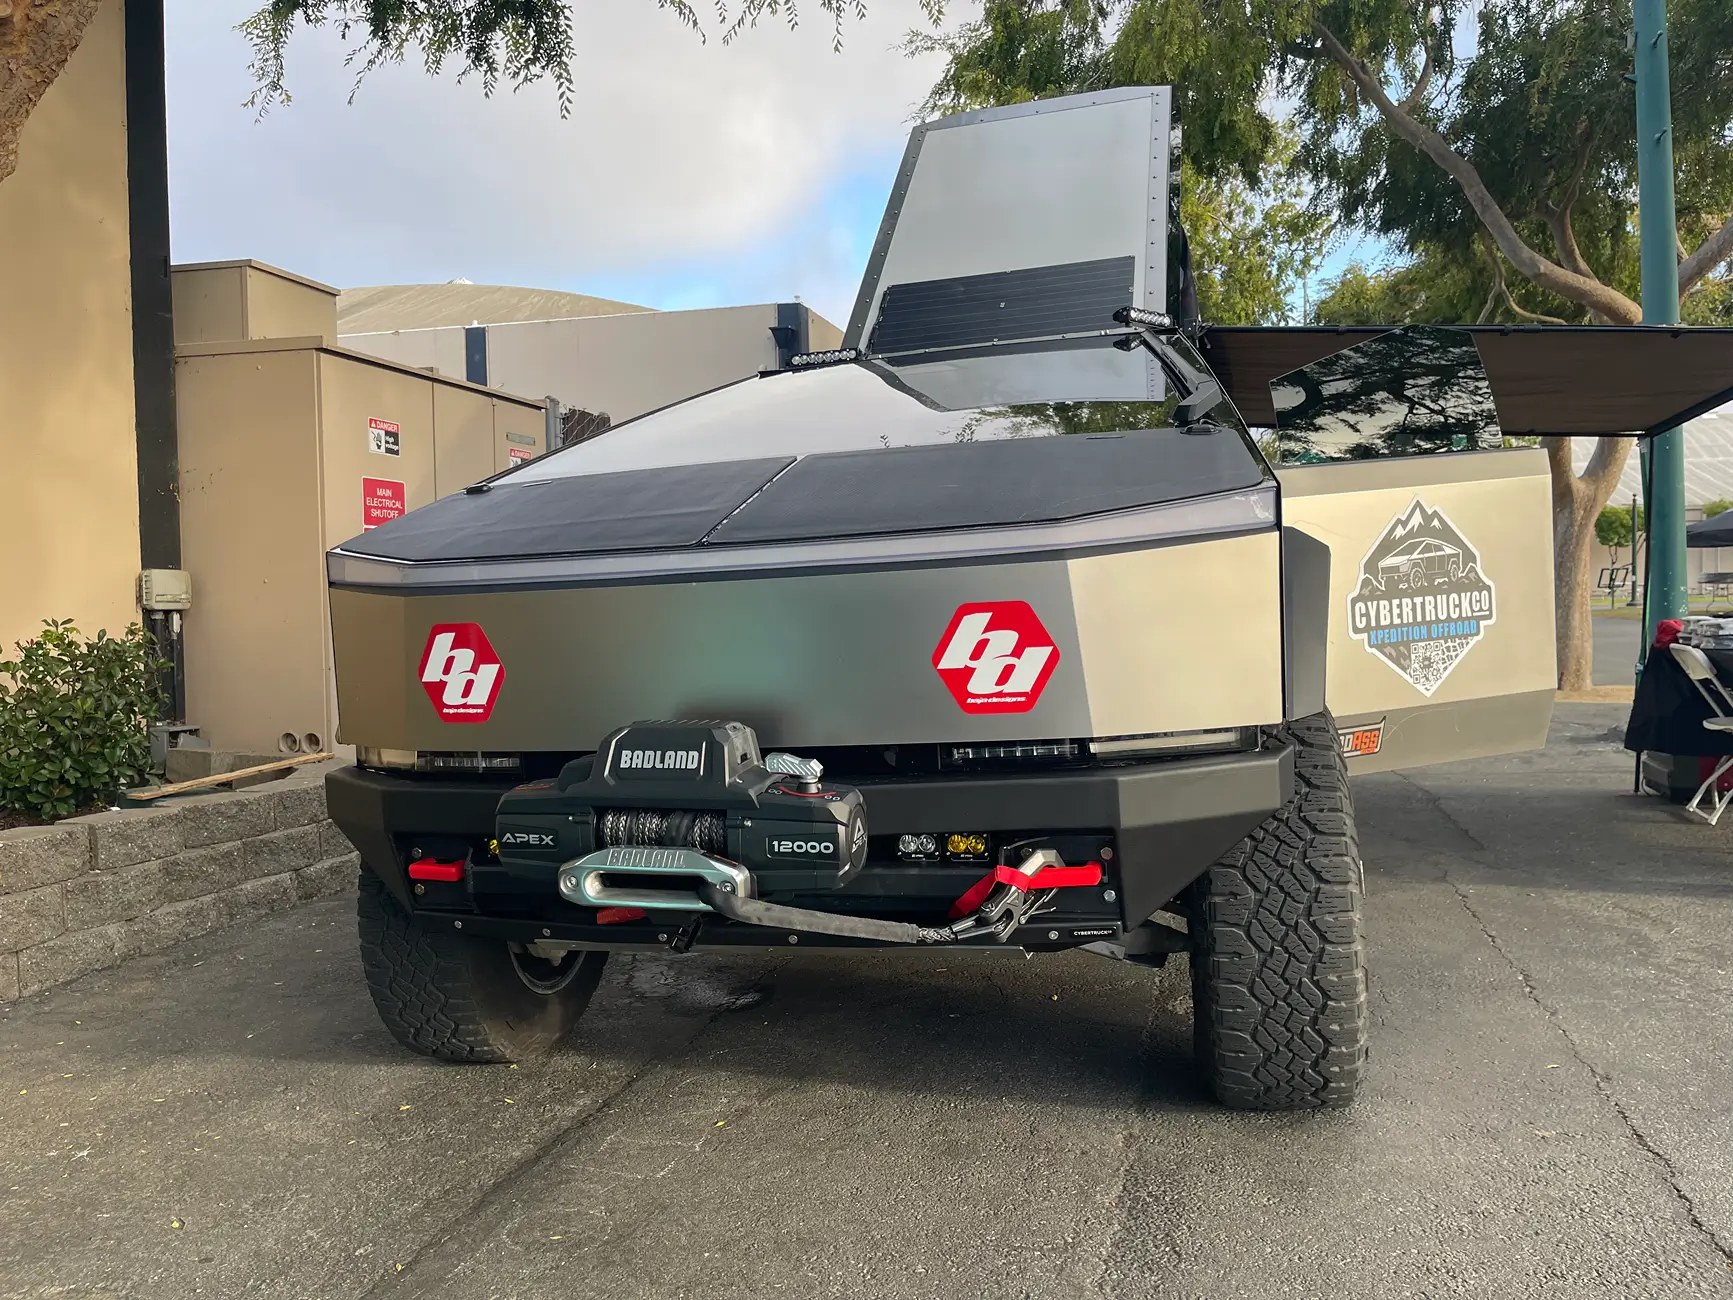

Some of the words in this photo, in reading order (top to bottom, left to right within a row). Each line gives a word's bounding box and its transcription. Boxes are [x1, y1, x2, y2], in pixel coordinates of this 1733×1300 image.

[376, 420, 398, 432] DANGER
[376, 487, 392, 497] MAIN
[366, 497, 403, 509] ELECTRICAL
[370, 508, 399, 519] SHUTOFF
[1369, 624, 1428, 645] XPEDITION
[1431, 619, 1478, 638] OFFROAD
[620, 750, 700, 769] BADLAND
[501, 832, 555, 846] APEX
[772, 840, 834, 854] 12000
[606, 849, 686, 868] BADLAND
